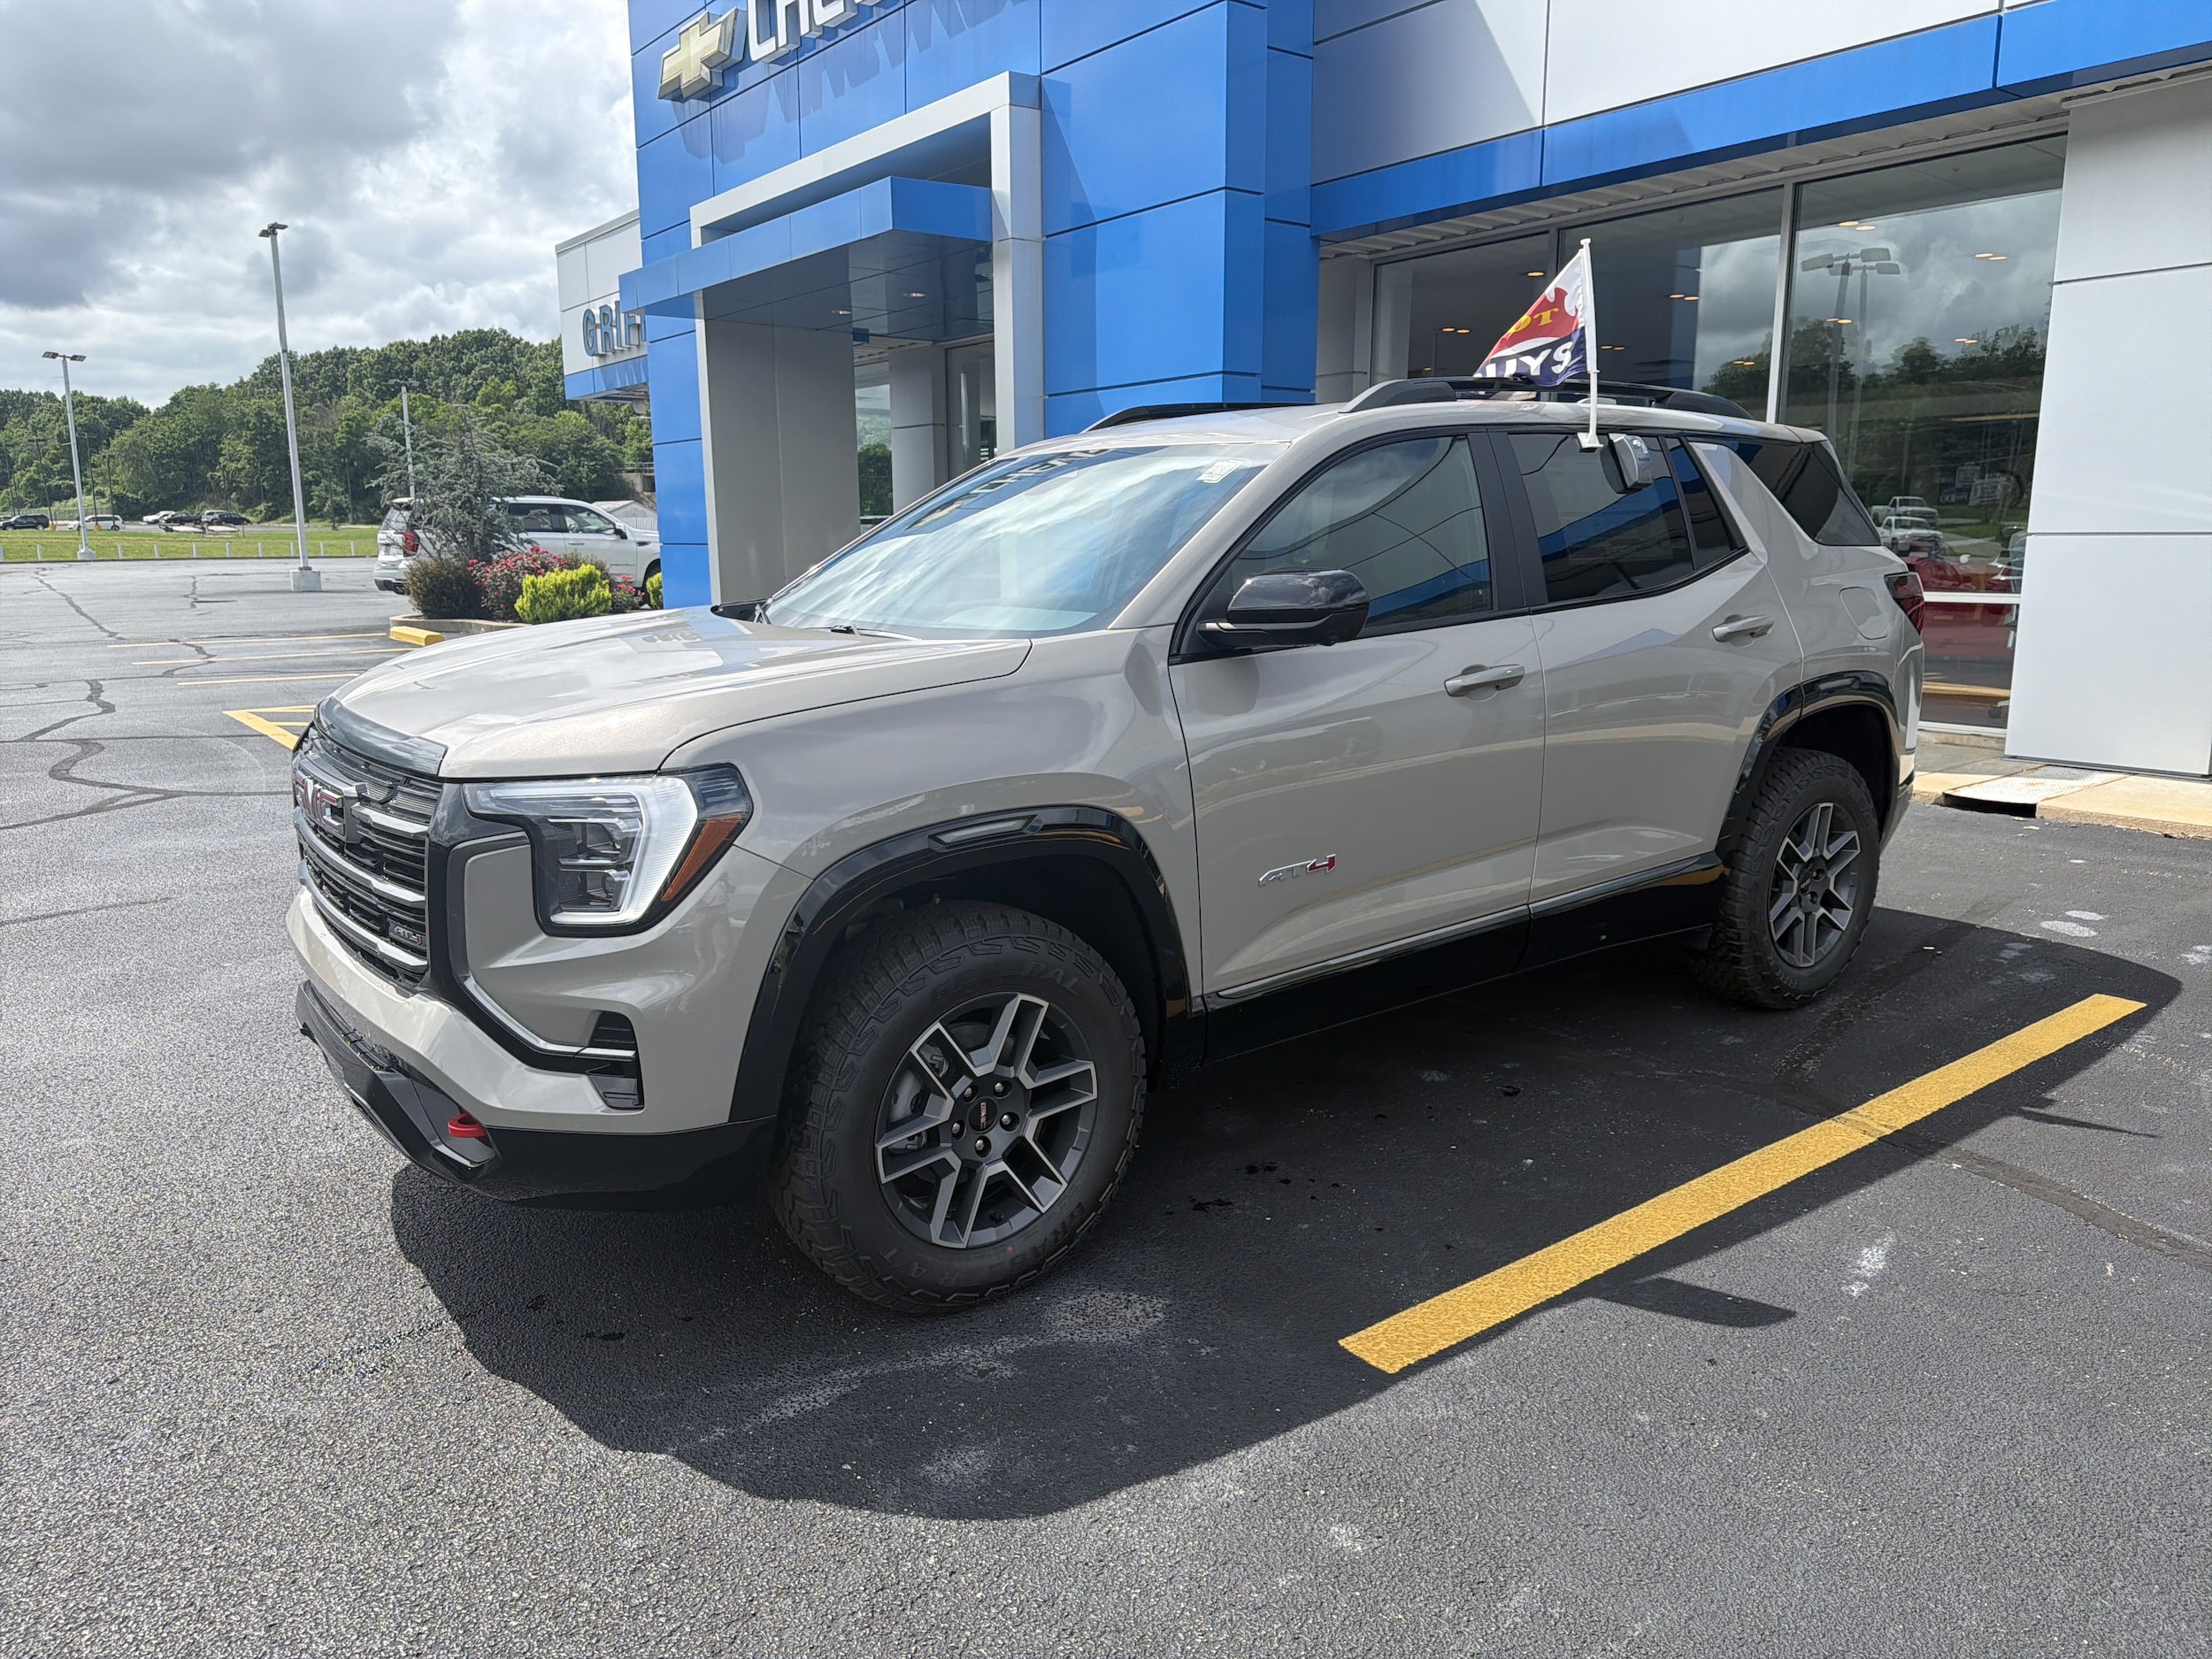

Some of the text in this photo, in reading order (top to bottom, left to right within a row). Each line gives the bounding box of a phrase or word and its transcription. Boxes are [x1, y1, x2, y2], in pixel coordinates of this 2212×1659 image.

[1473, 342, 1572, 377] UYS
[1258, 853, 1336, 887] AT4
[394, 926, 422, 945] AT4
